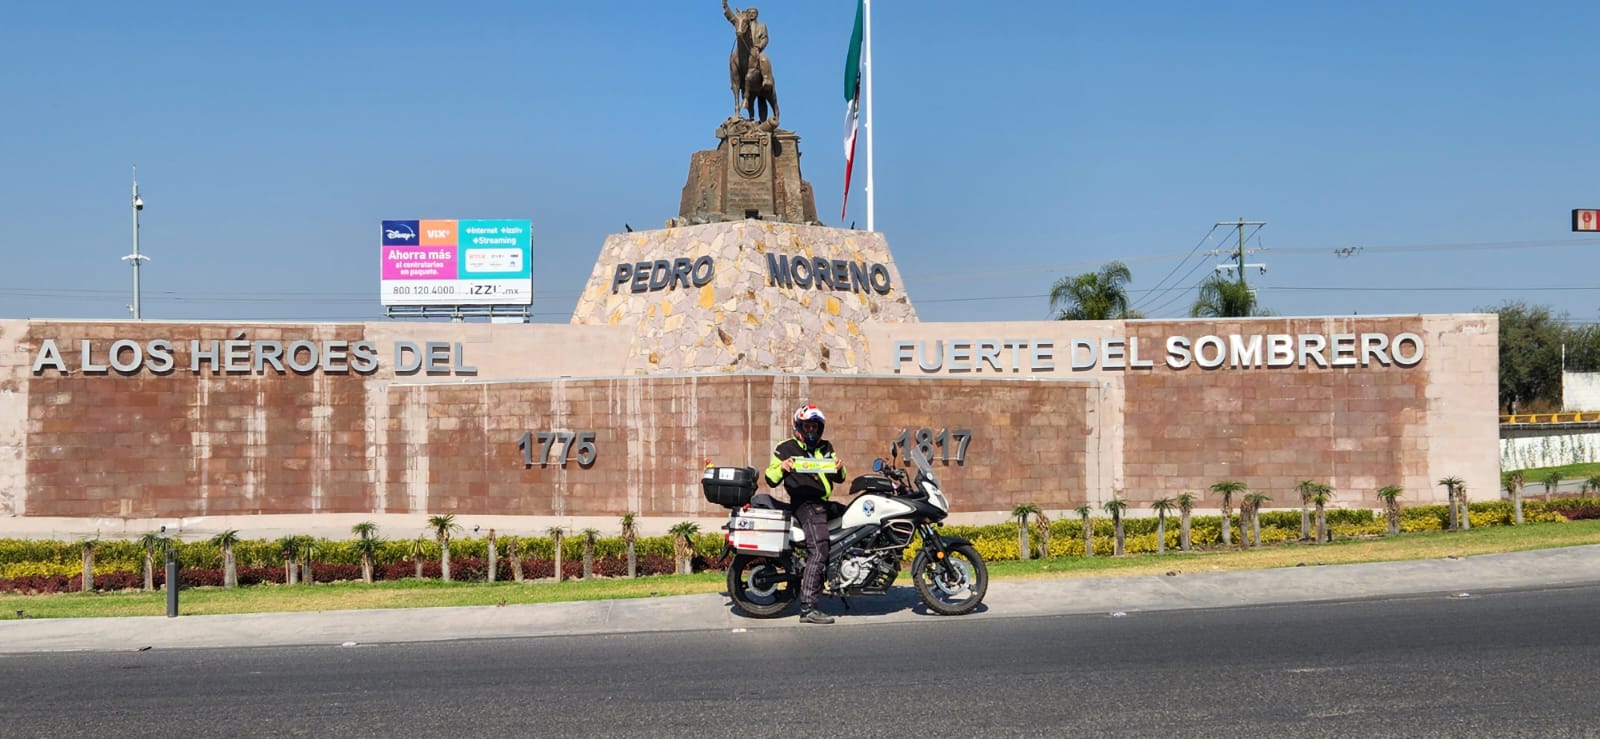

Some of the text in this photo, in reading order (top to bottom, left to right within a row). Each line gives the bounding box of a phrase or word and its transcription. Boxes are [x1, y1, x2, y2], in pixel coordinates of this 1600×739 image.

[388, 248, 451, 260] Ahorra más
[612, 252, 891, 295] PEDRO MORENO
[32, 331, 478, 376] A LOS HÉROES DEL
[893, 332, 1425, 373] FUERTE DEL SOMBRERO
[517, 431, 597, 469] 1775
[897, 428, 973, 466] 1817
